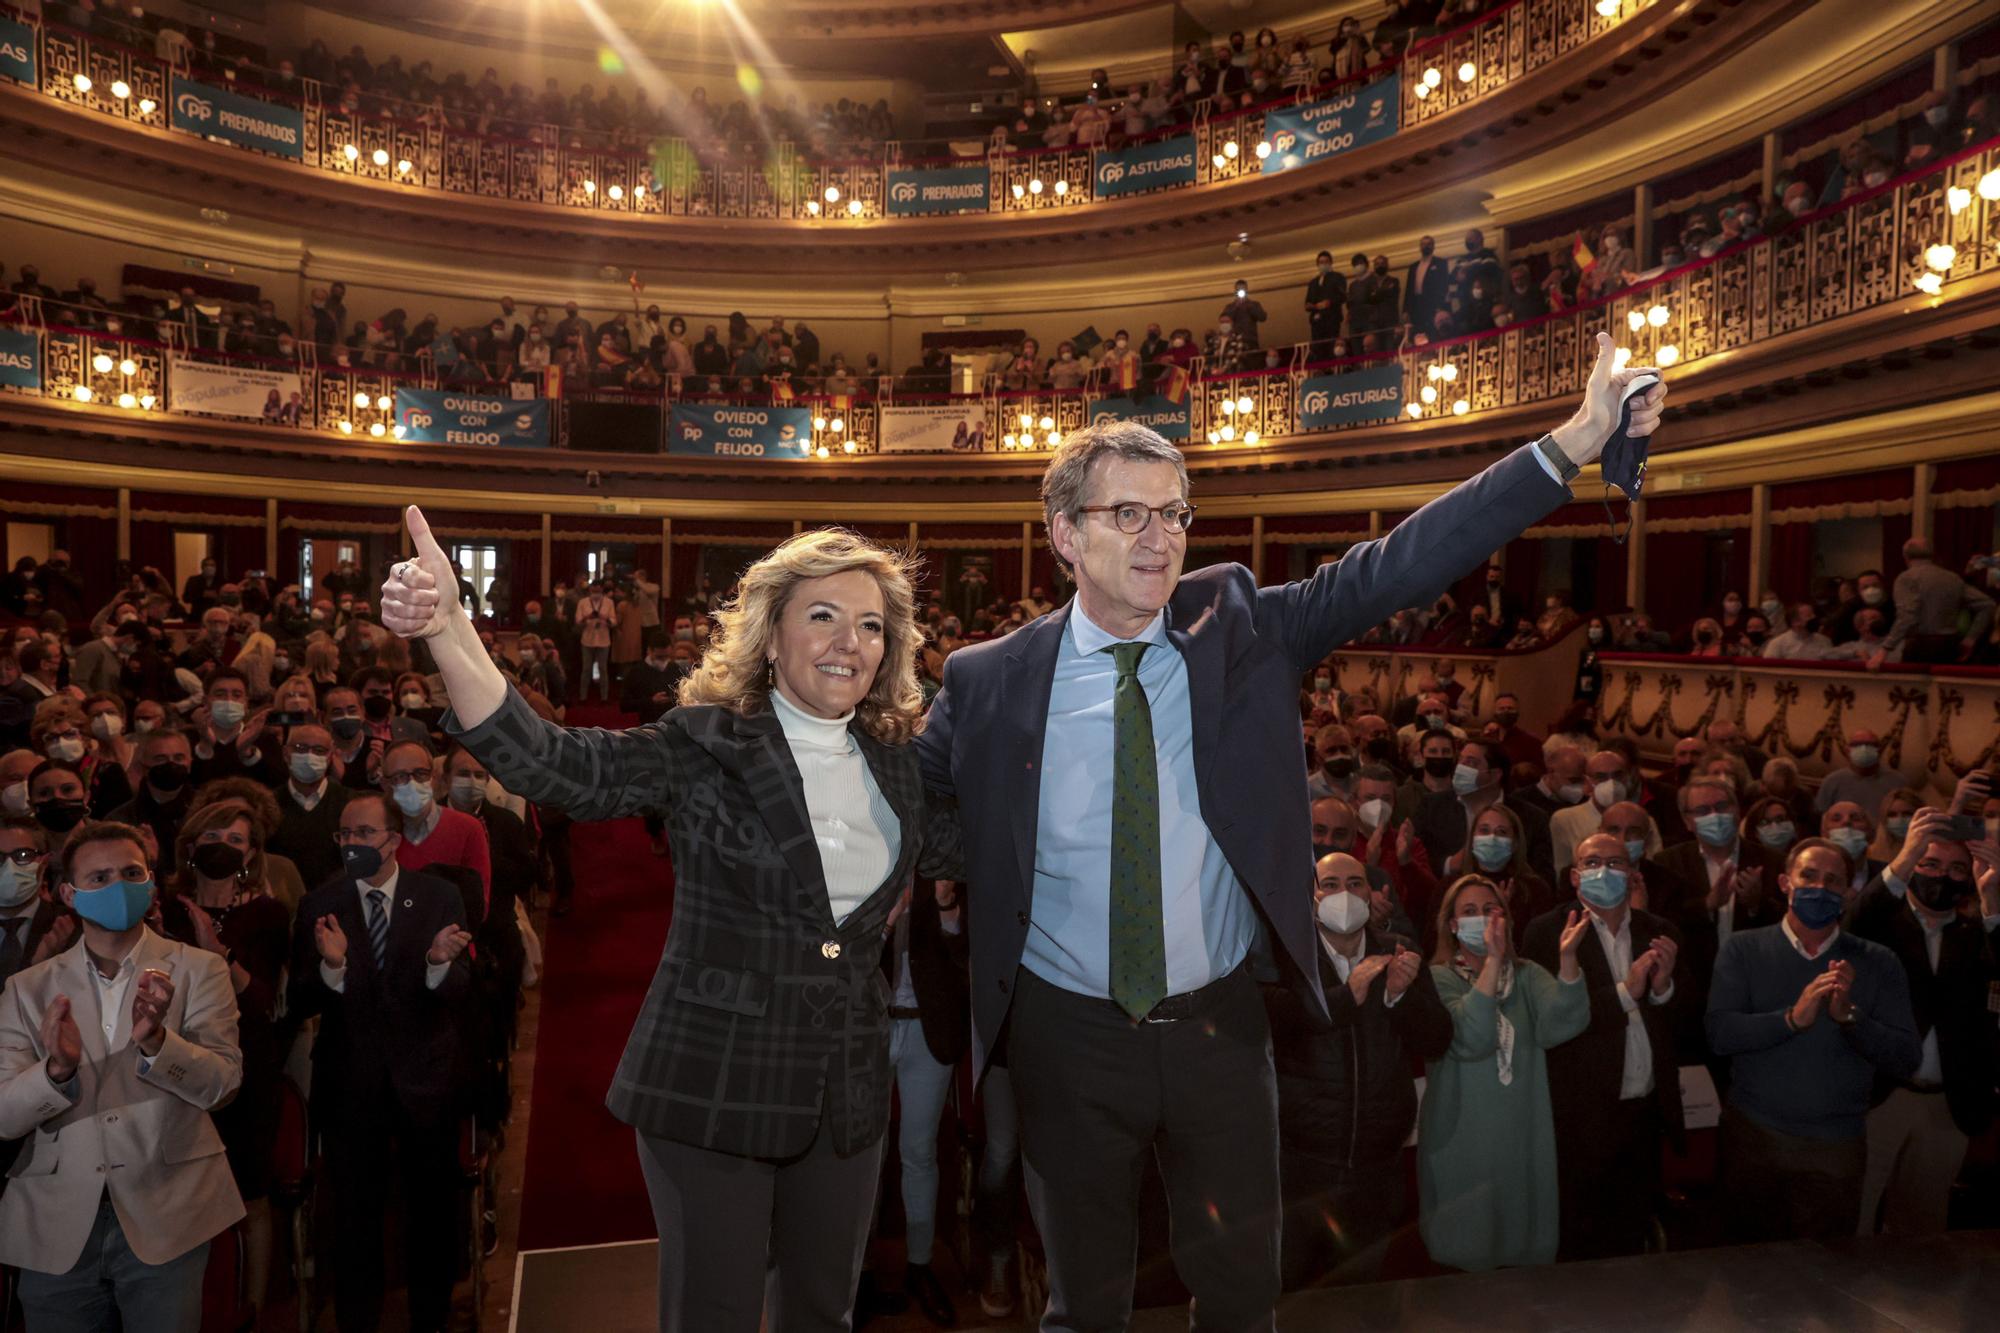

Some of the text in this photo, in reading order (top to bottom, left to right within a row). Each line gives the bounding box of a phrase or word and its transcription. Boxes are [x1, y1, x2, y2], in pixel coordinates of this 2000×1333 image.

[219, 110, 297, 145] PREPARADOS
[1316, 115, 1342, 134] CON
[1305, 132, 1354, 158] FEIJOO
[1128, 154, 1193, 177] ASTURIAS
[922, 183, 985, 201] PREPARADOS
[443, 398, 503, 414] OVIEDO
[1332, 386, 1398, 409] ASTURIAS
[459, 415, 487, 427] CON
[713, 410, 769, 425] OVIEDO
[446, 430, 500, 446] FEIJOO
[727, 427, 753, 438] CON
[714, 442, 765, 457] FEIJOO
